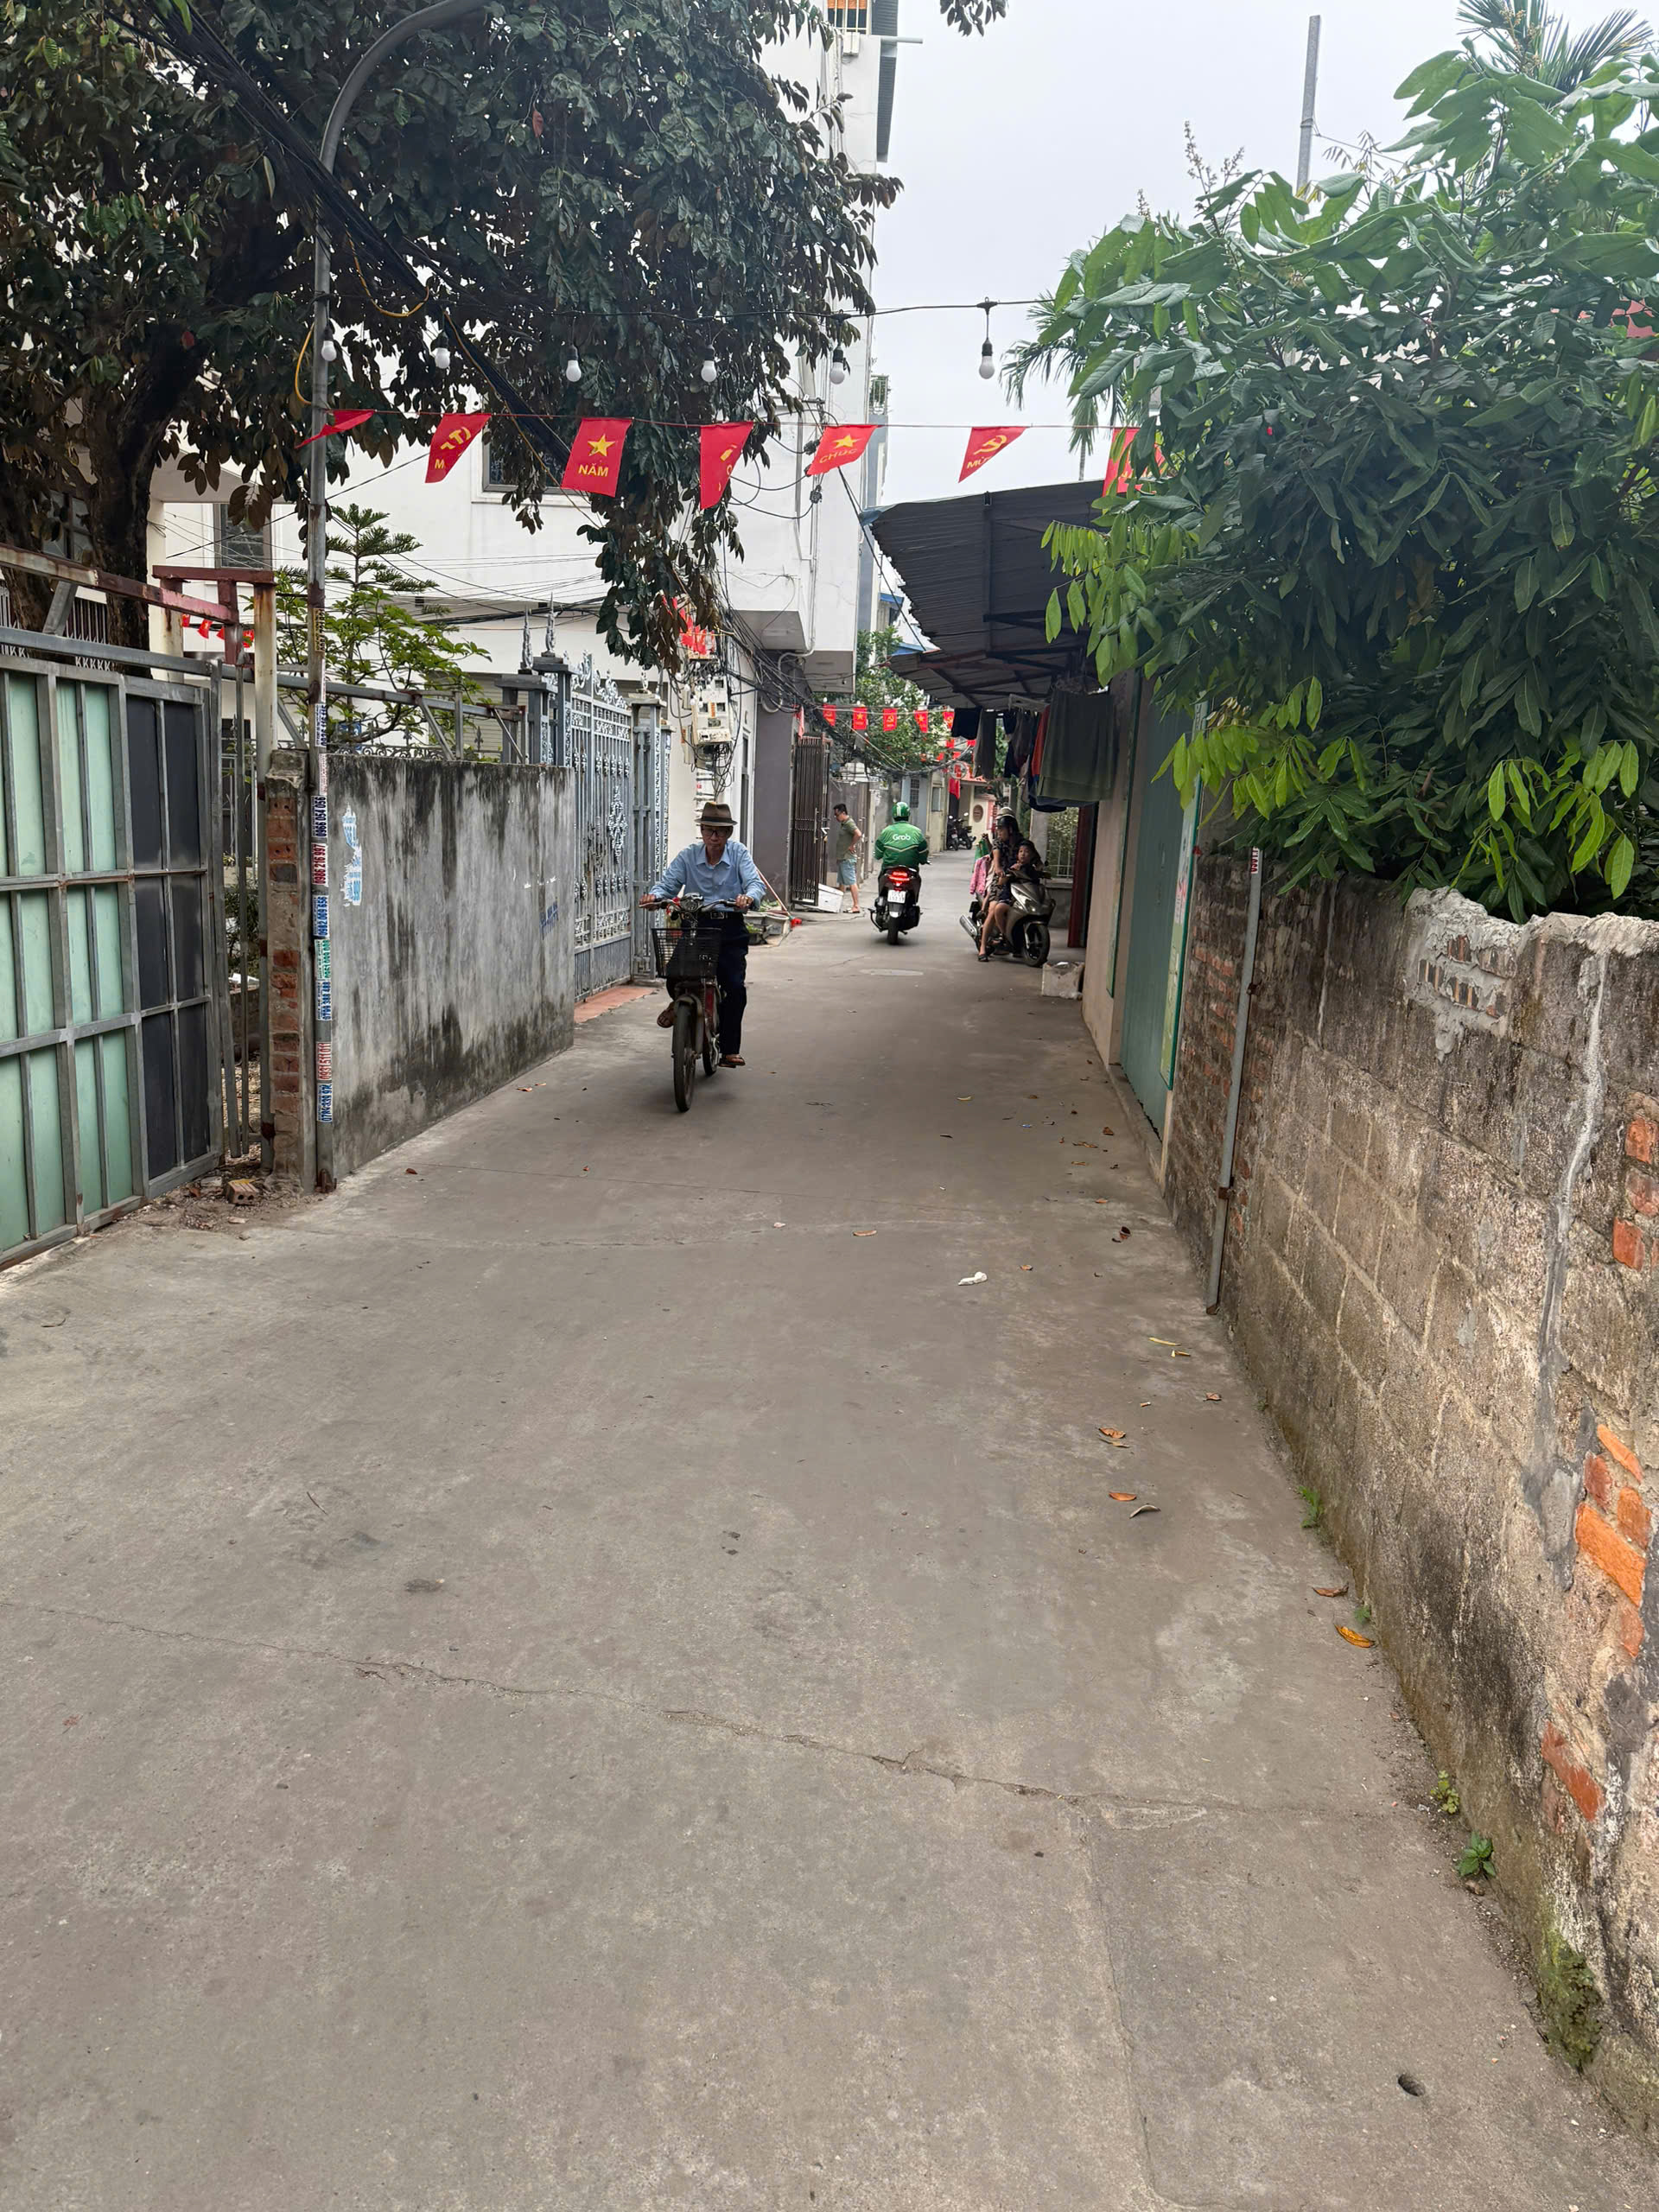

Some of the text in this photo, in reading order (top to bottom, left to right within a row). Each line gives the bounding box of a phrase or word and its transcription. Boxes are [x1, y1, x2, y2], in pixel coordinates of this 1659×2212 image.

[578, 462, 608, 477] NĂM
[315, 797, 326, 808] 056
[315, 809, 326, 821] 054
[315, 822, 327, 836] 0966
[314, 843, 325, 855] 997
[315, 857, 325, 868] 216
